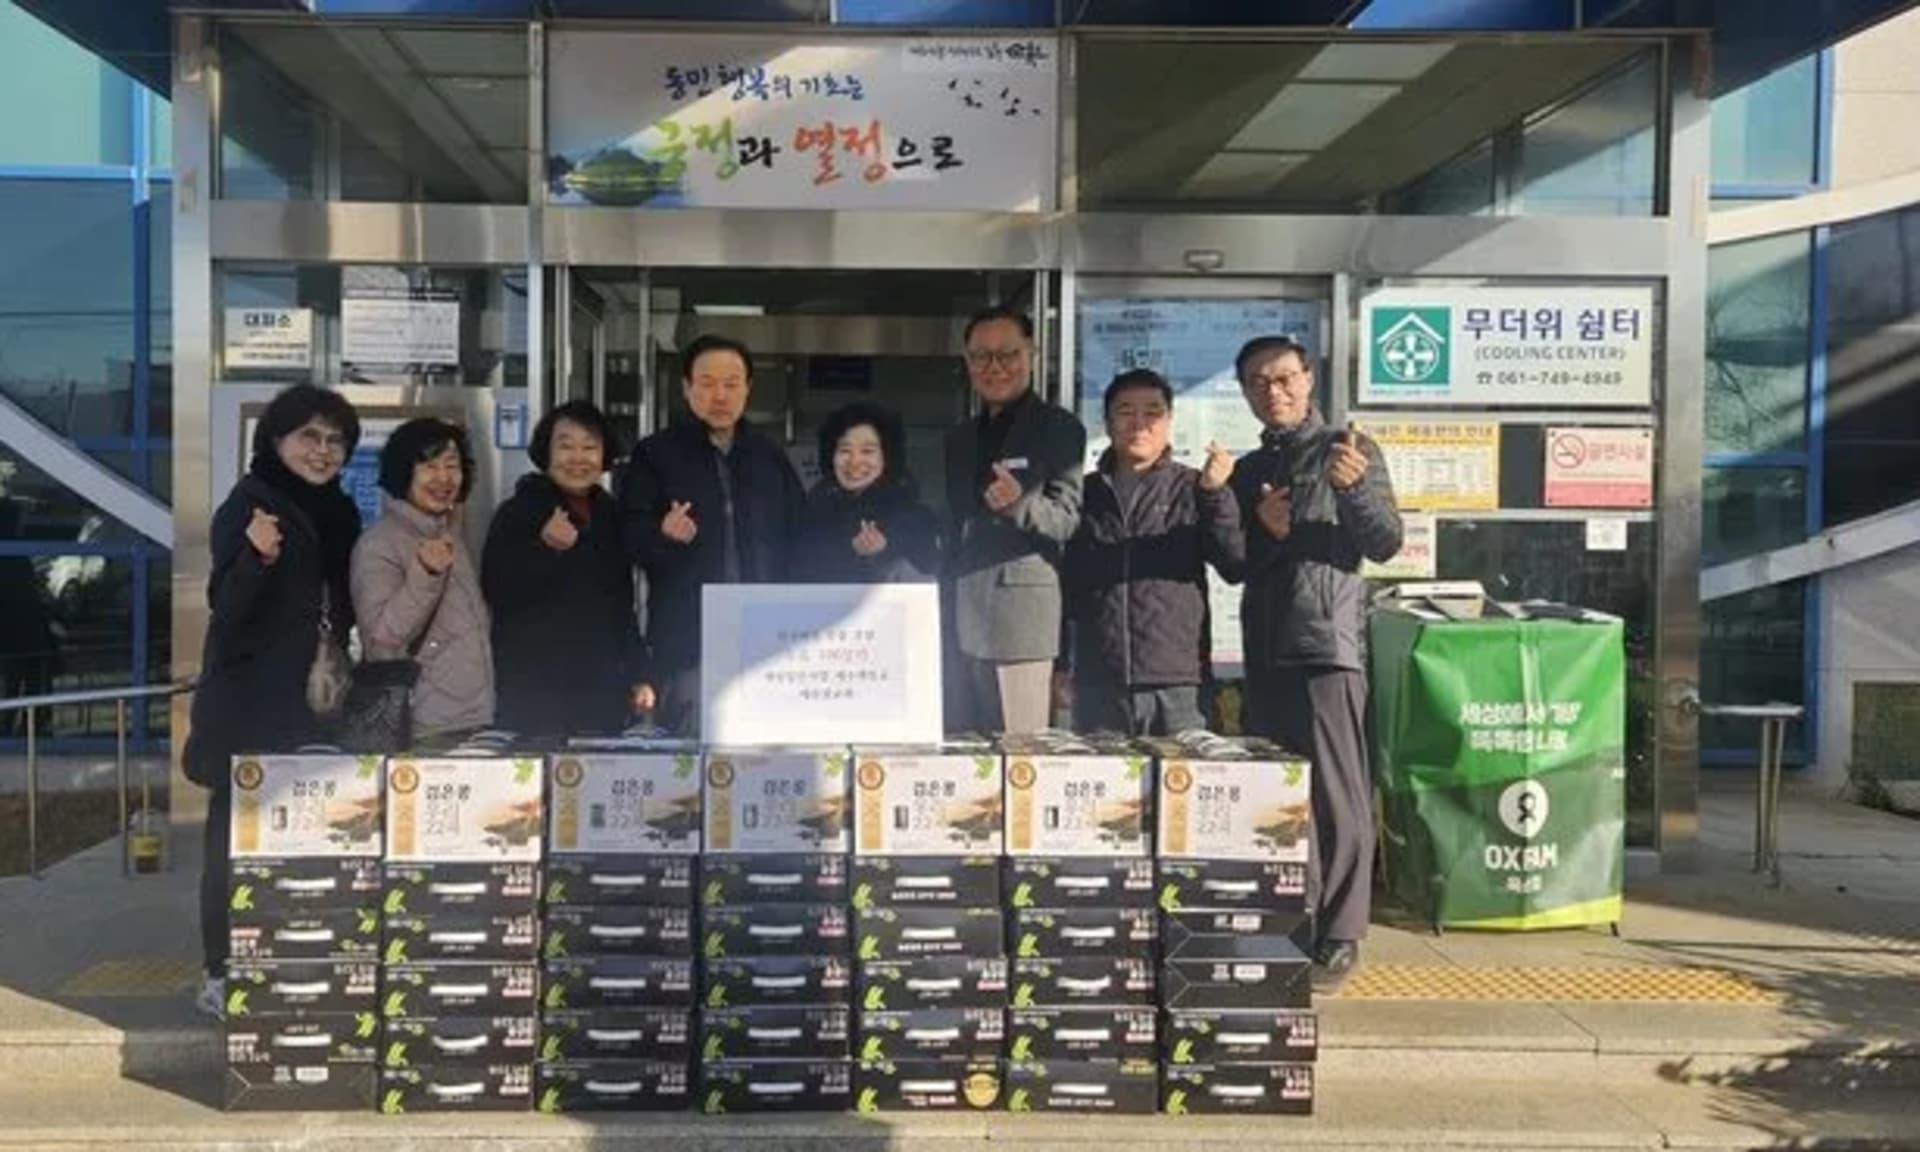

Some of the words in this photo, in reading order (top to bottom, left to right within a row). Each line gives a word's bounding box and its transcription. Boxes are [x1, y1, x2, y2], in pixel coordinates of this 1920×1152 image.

[664, 66, 712, 100] 동민
[718, 65, 792, 100] 행복의
[799, 72, 864, 100] 기초는
[793, 118, 963, 184] 열정으로
[1463, 308, 1562, 340] 무더위
[1577, 308, 1640, 341] 쉼터
[1475, 348, 1552, 361] (COOLING
[1556, 348, 1626, 361] CENTER)
